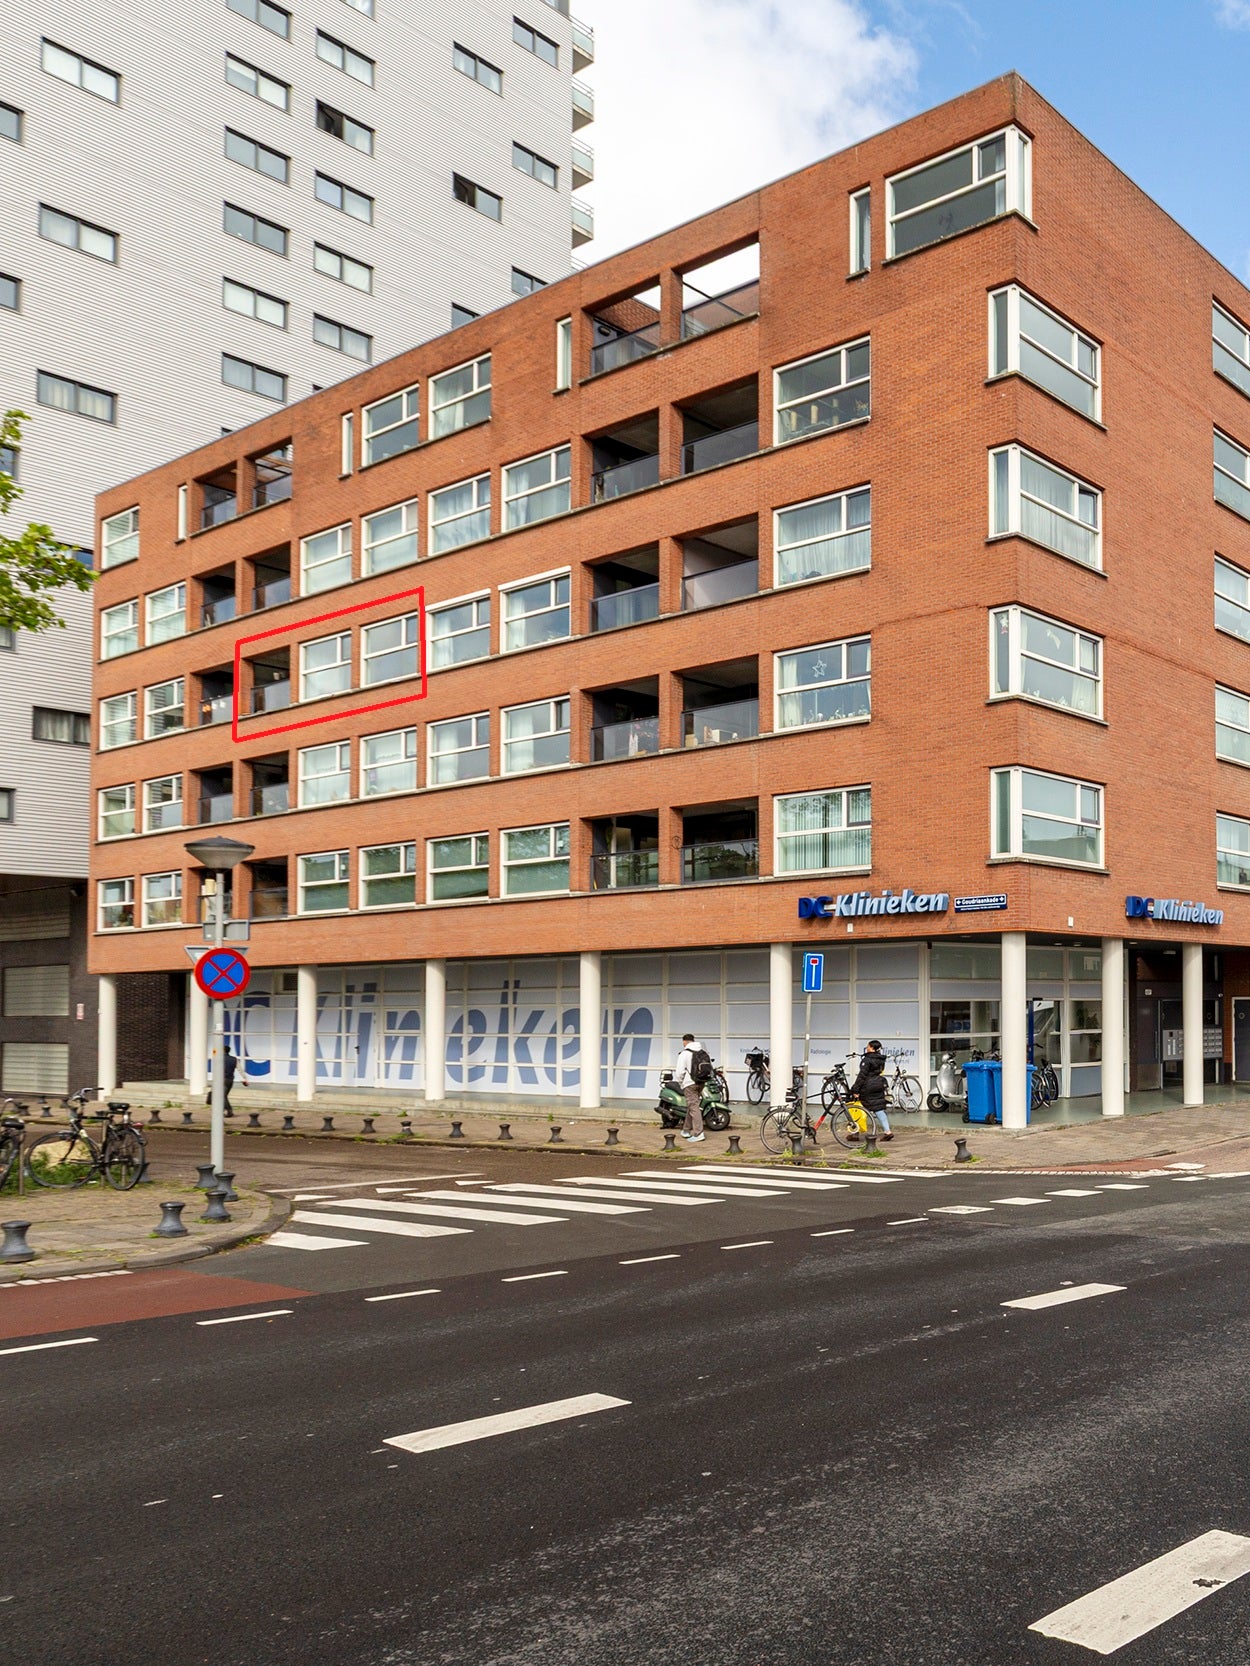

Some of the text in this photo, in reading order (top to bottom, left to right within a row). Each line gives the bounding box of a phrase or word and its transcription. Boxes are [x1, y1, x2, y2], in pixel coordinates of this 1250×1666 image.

[798, 889, 949, 919] DC Klinieken
[1125, 896, 1224, 925] DC Klinieken
[288, 979, 654, 1089] Klineken
[881, 1047, 915, 1057] linieken
